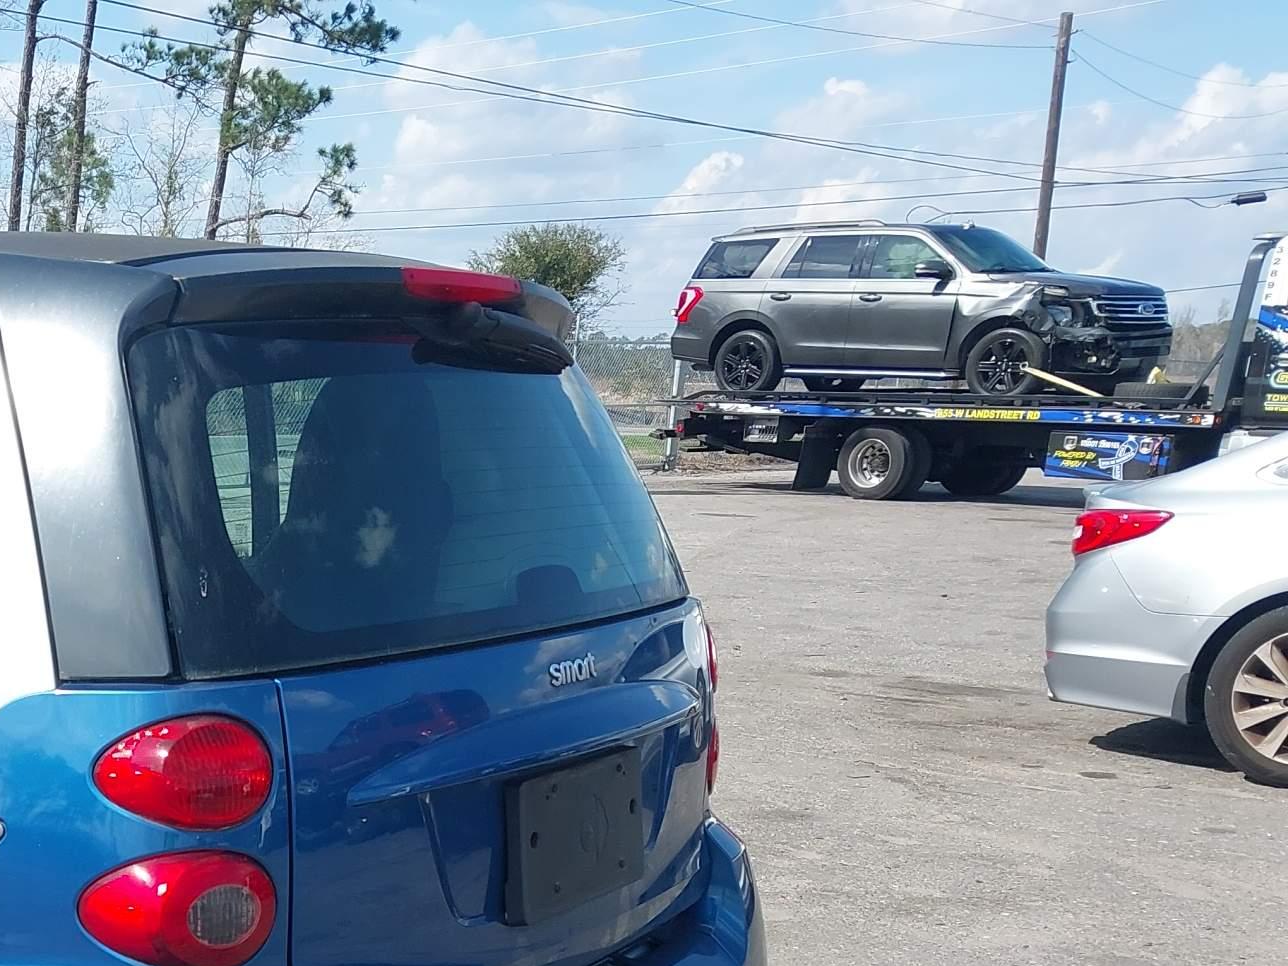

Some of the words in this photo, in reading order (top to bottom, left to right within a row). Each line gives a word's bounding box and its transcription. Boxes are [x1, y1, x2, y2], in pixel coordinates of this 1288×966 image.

[955, 408, 965, 418] W
[965, 409, 1026, 419] LANDSTREET
[1026, 410, 1041, 420] RD
[549, 652, 597, 687] smart
